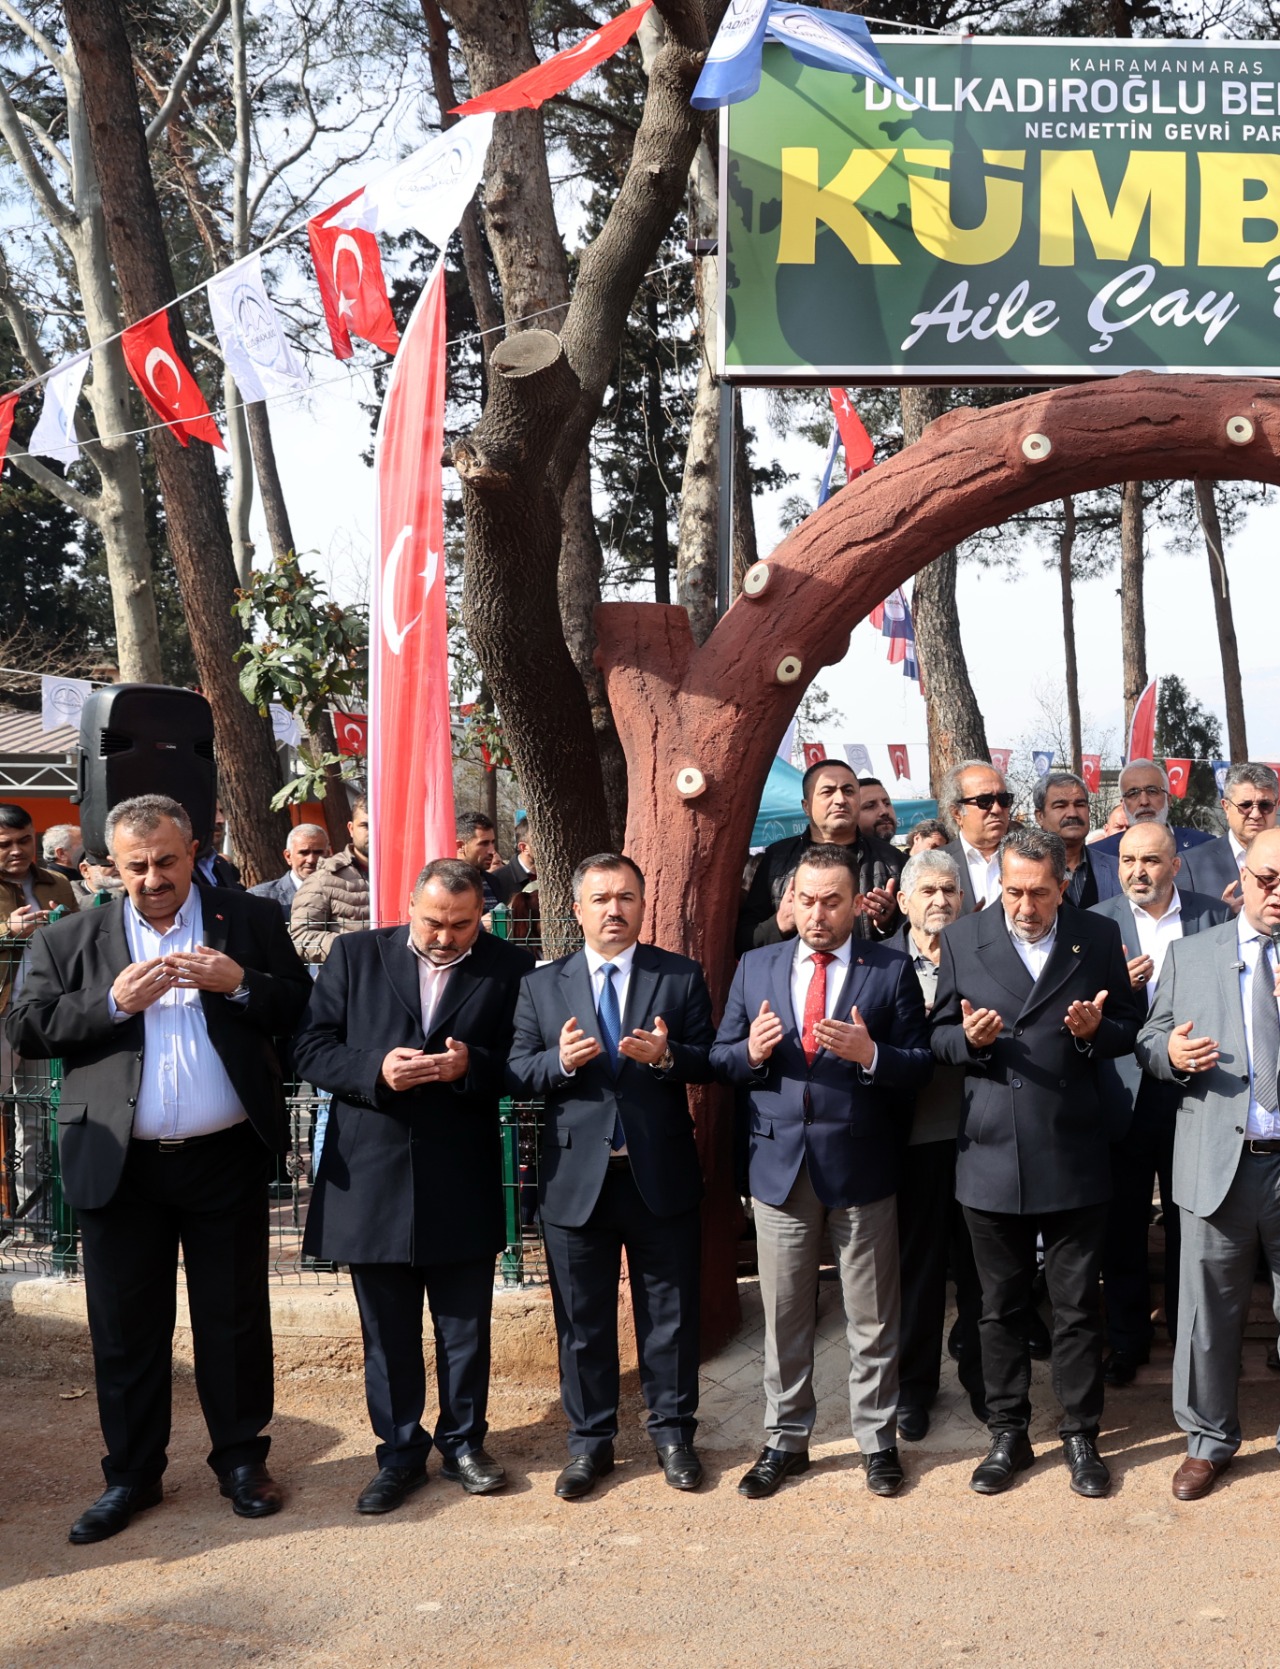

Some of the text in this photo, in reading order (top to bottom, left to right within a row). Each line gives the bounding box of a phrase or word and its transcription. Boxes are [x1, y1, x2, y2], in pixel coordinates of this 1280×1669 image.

[1070, 58, 1263, 76] KAHRAMANMARAŞ
[1025, 119, 1152, 140] NECMETTİN
[1164, 121, 1230, 141] GEVRİ
[900, 279, 1060, 351] Aile
[1086, 264, 1241, 353] Çay
